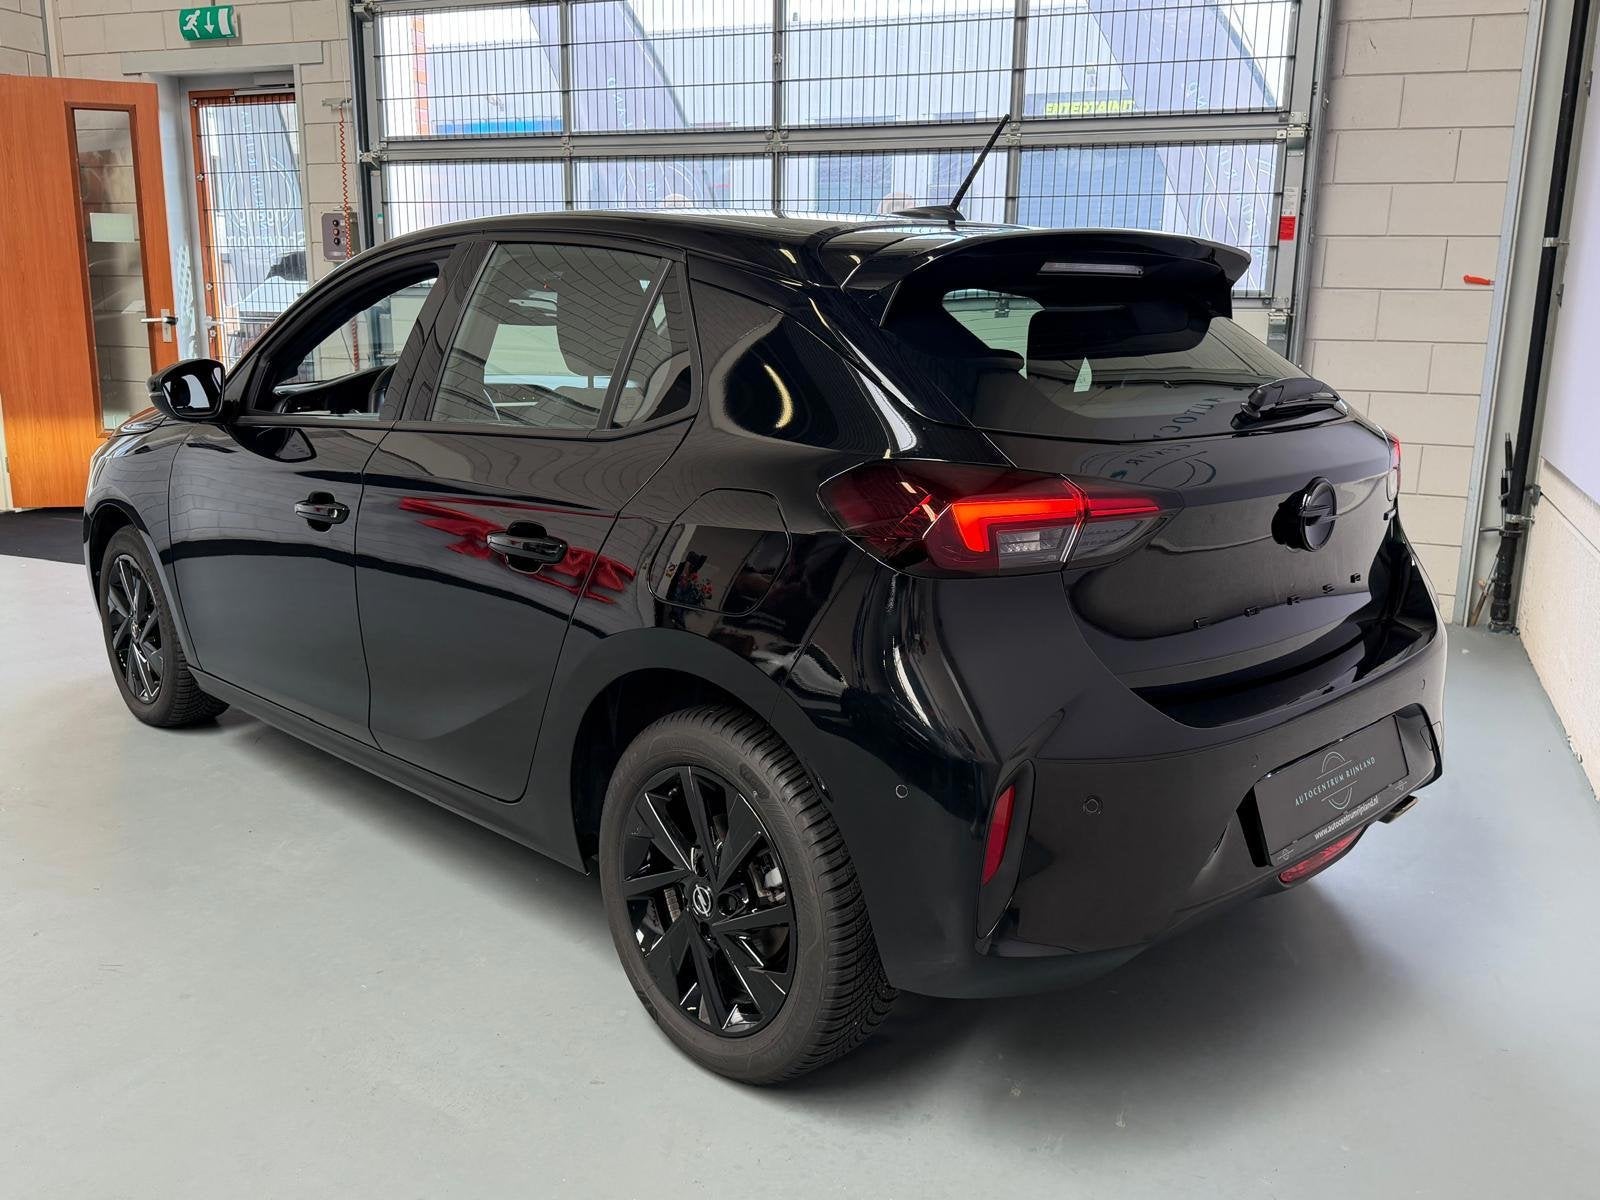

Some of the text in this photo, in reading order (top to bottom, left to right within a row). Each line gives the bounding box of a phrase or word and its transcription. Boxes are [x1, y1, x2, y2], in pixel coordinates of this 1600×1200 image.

[1295, 756, 1376, 807] AUTOCENTRUM RIJNLAND
[1314, 797, 1379, 839] www.autocentrumrijnland.nl
